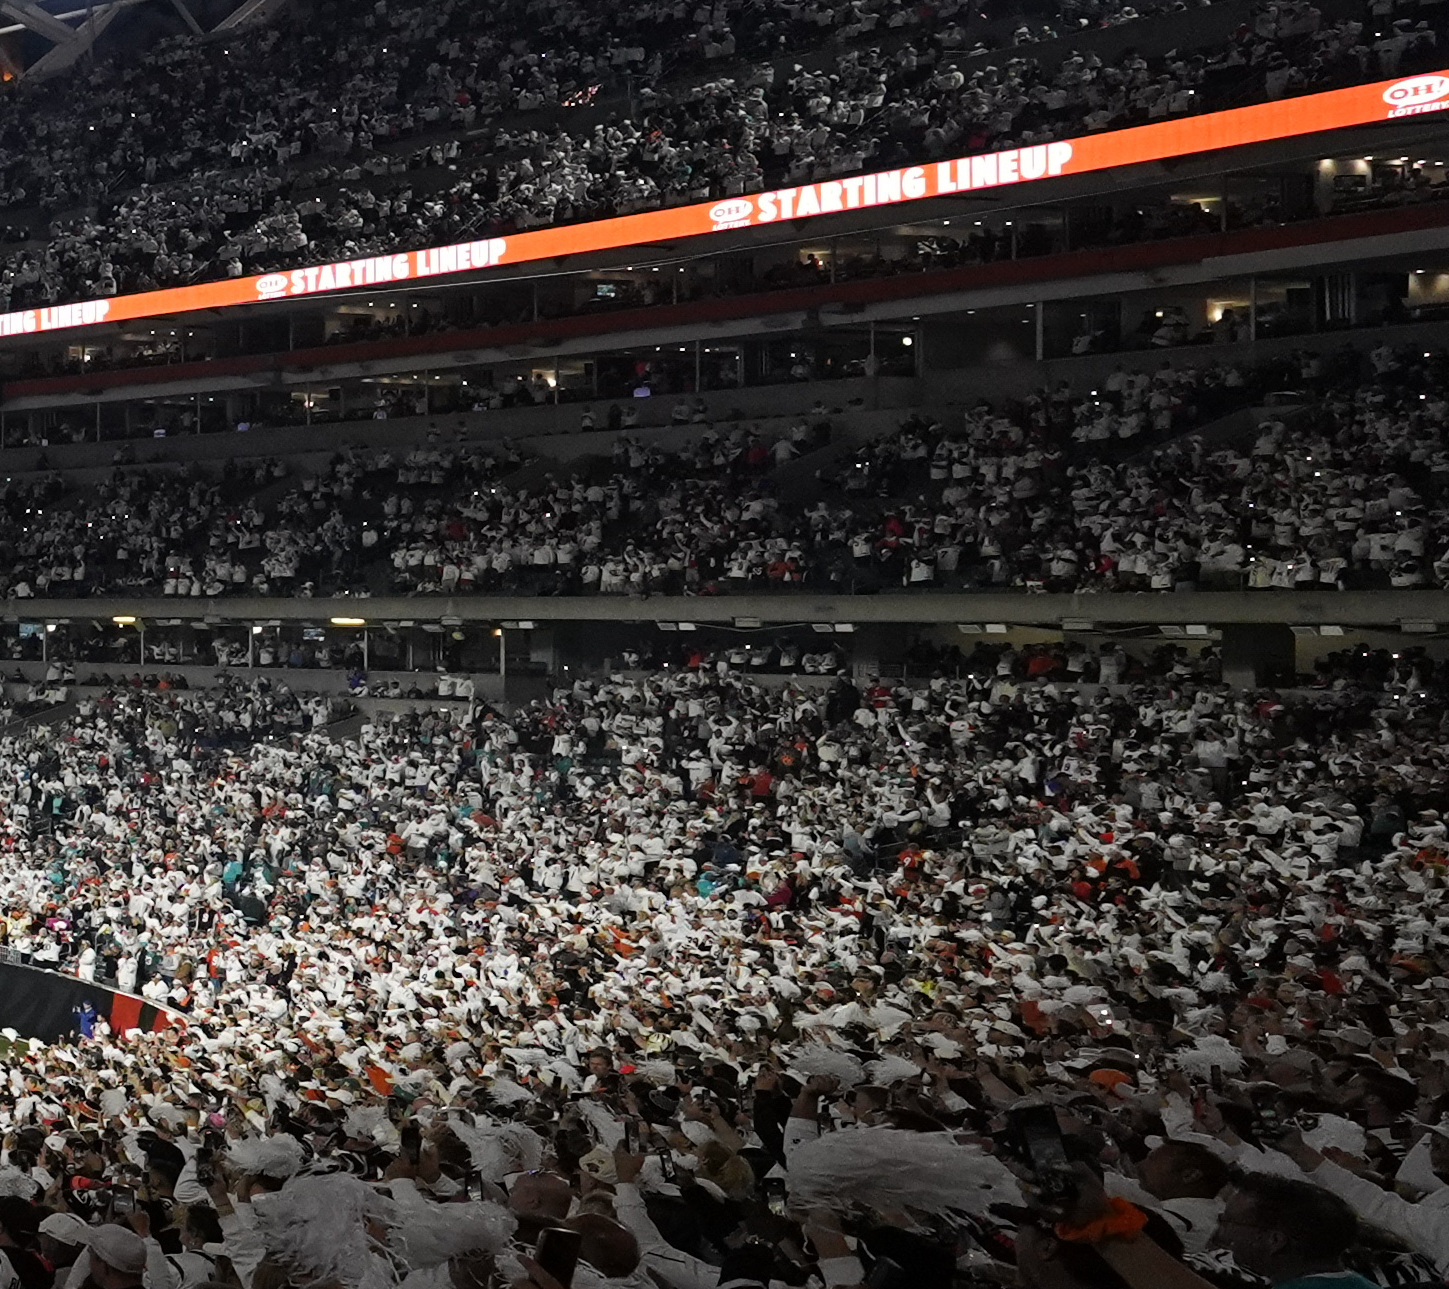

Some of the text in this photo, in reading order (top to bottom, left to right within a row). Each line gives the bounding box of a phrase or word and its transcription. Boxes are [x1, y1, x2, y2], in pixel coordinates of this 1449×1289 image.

[1390, 79, 1445, 100] OH!
[758, 142, 1073, 222] STARTING LINEUP
[291, 238, 506, 294] STARTING LINEUP
[41, 299, 109, 331] LINEUP
